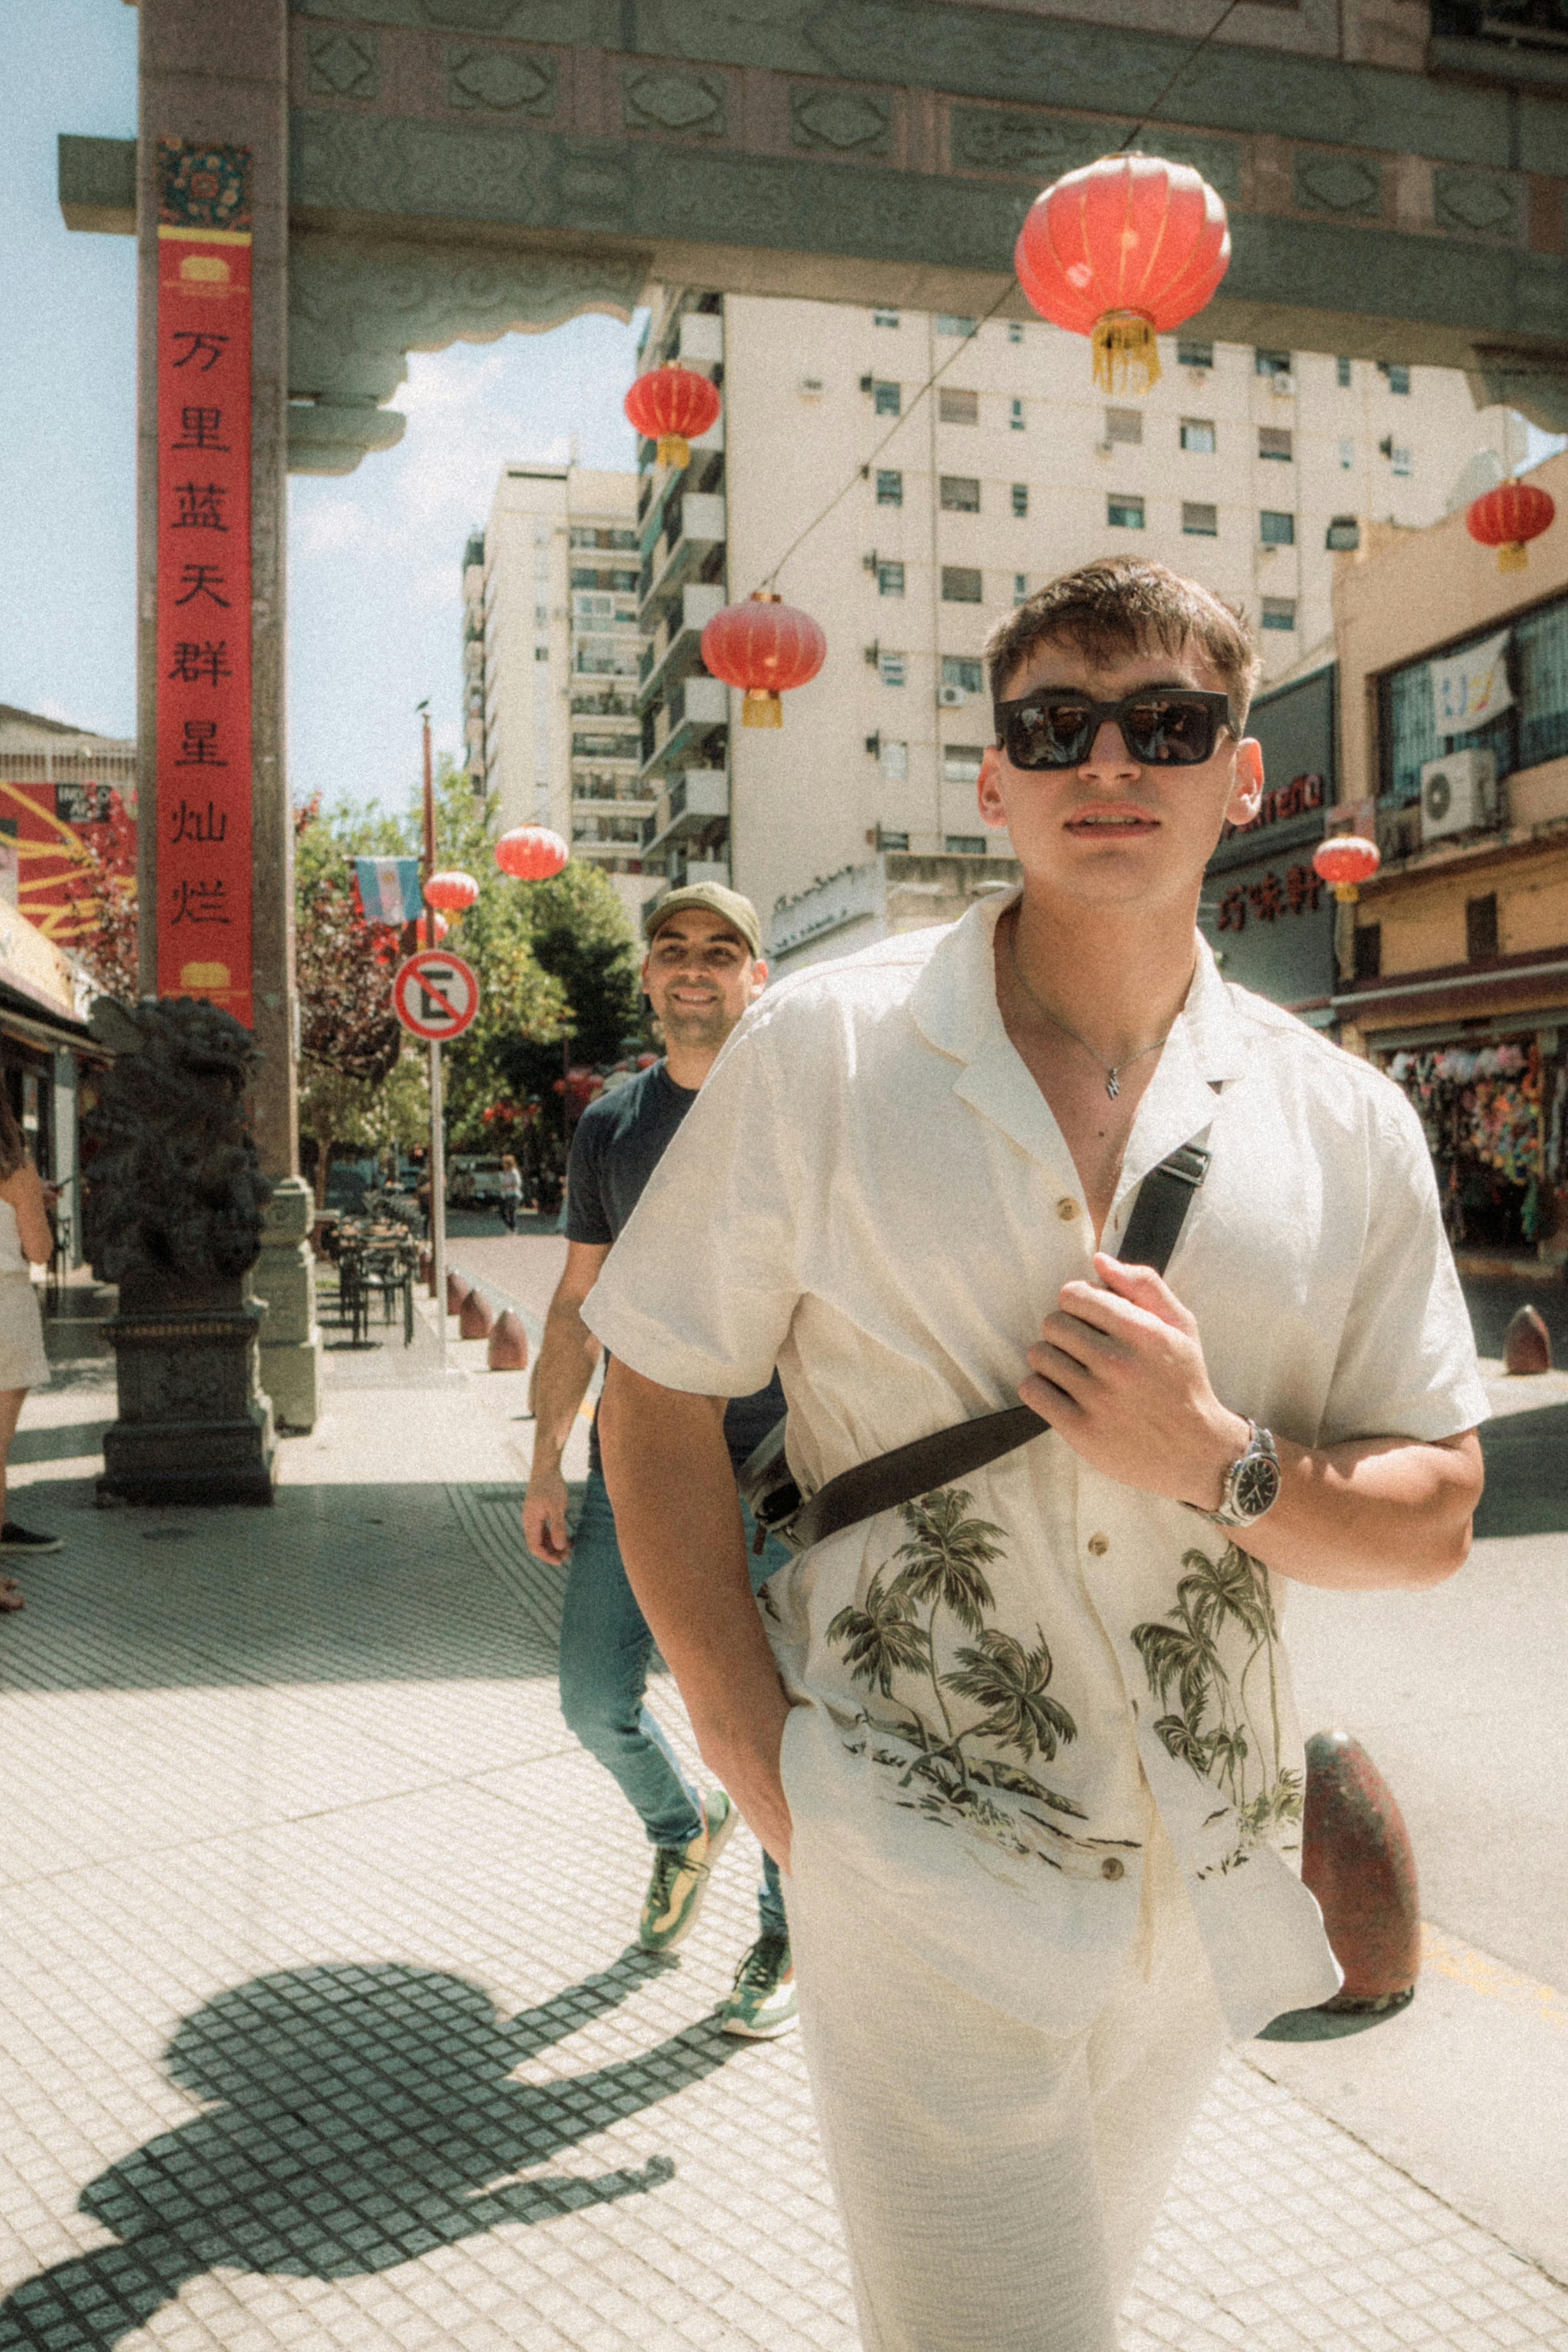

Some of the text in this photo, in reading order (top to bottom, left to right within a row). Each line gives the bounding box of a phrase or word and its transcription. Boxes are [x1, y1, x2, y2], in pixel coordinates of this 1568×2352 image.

[168, 331, 233, 925] 万里蓝天群星灿烂
[420, 971, 453, 1019] E
